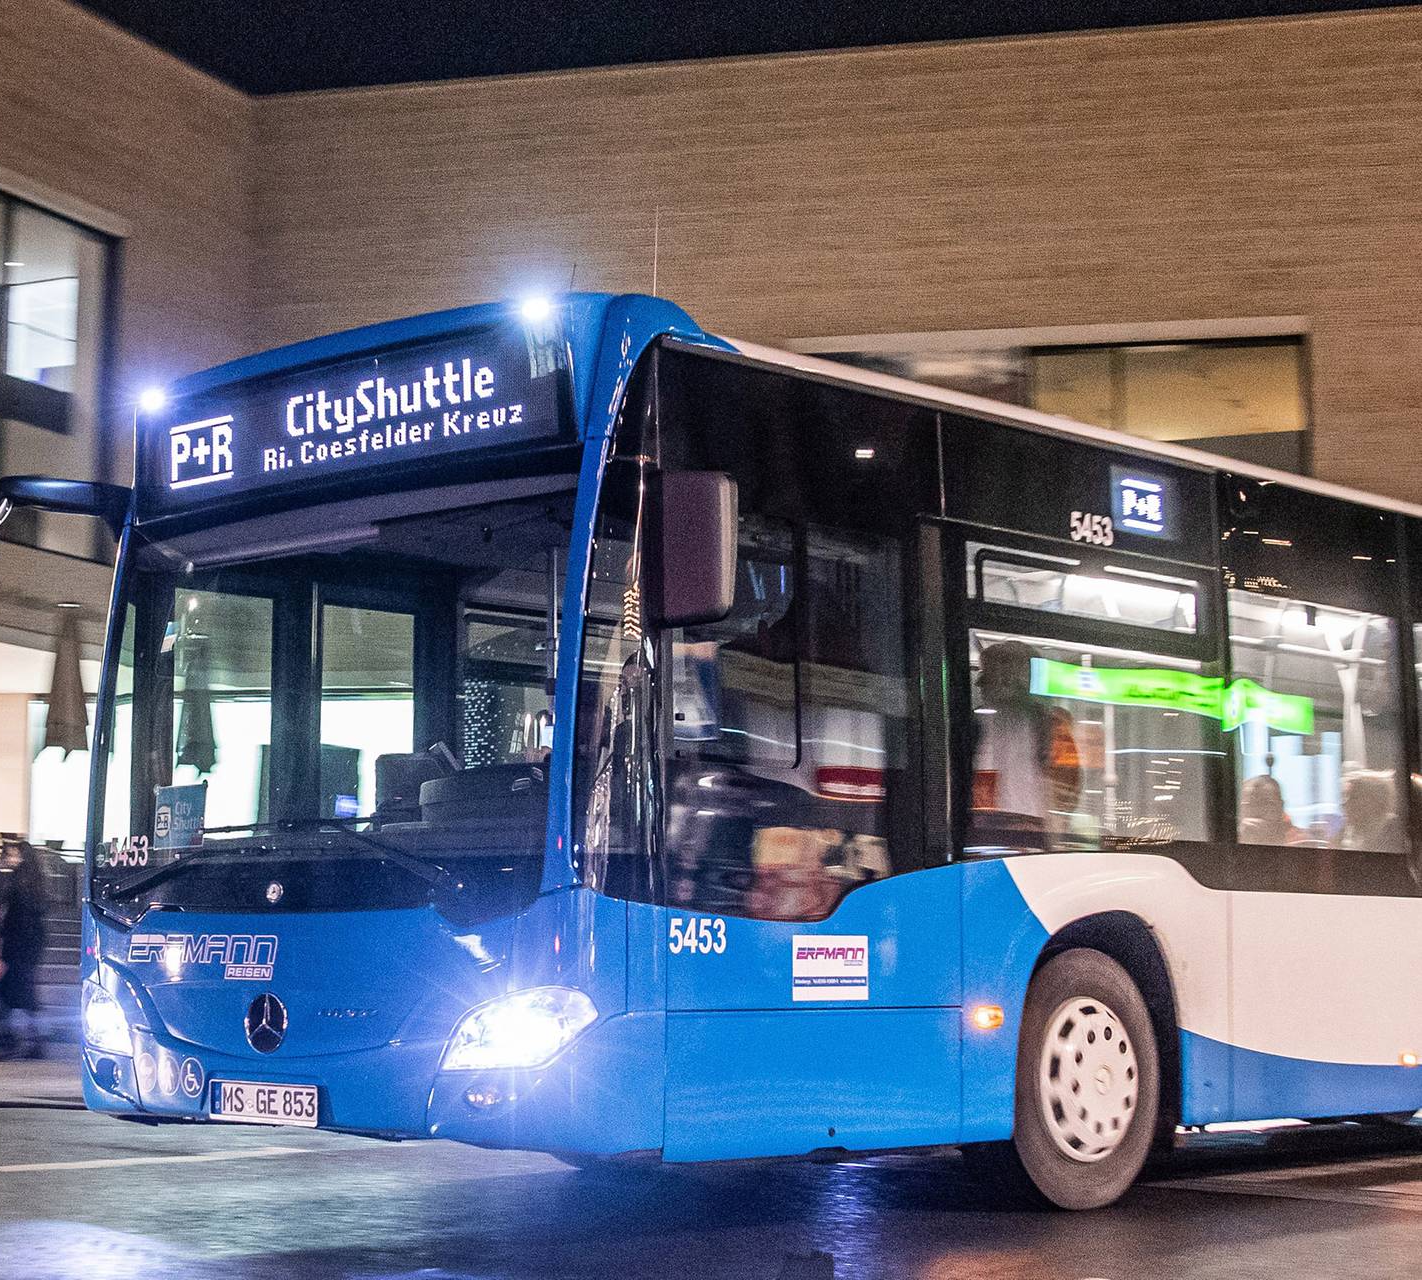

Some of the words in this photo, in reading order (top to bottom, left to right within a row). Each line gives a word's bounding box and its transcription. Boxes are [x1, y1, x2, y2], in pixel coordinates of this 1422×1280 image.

[286, 358, 494, 437] CityShuttle
[171, 424, 233, 482] P+R
[263, 446, 293, 472] Ri.
[300, 422, 434, 464] Coesfelder
[443, 404, 523, 437] Kreuz
[1122, 489, 1163, 521] P+R
[1070, 511, 1114, 546] 5453
[109, 835, 149, 867] 5453
[669, 918, 727, 954] 5453
[796, 947, 865, 960] ERFMANN
[227, 966, 271, 978] REISEN
[222, 1086, 244, 1113] MS
[256, 1088, 278, 1115] GE
[282, 1090, 316, 1118] 853
